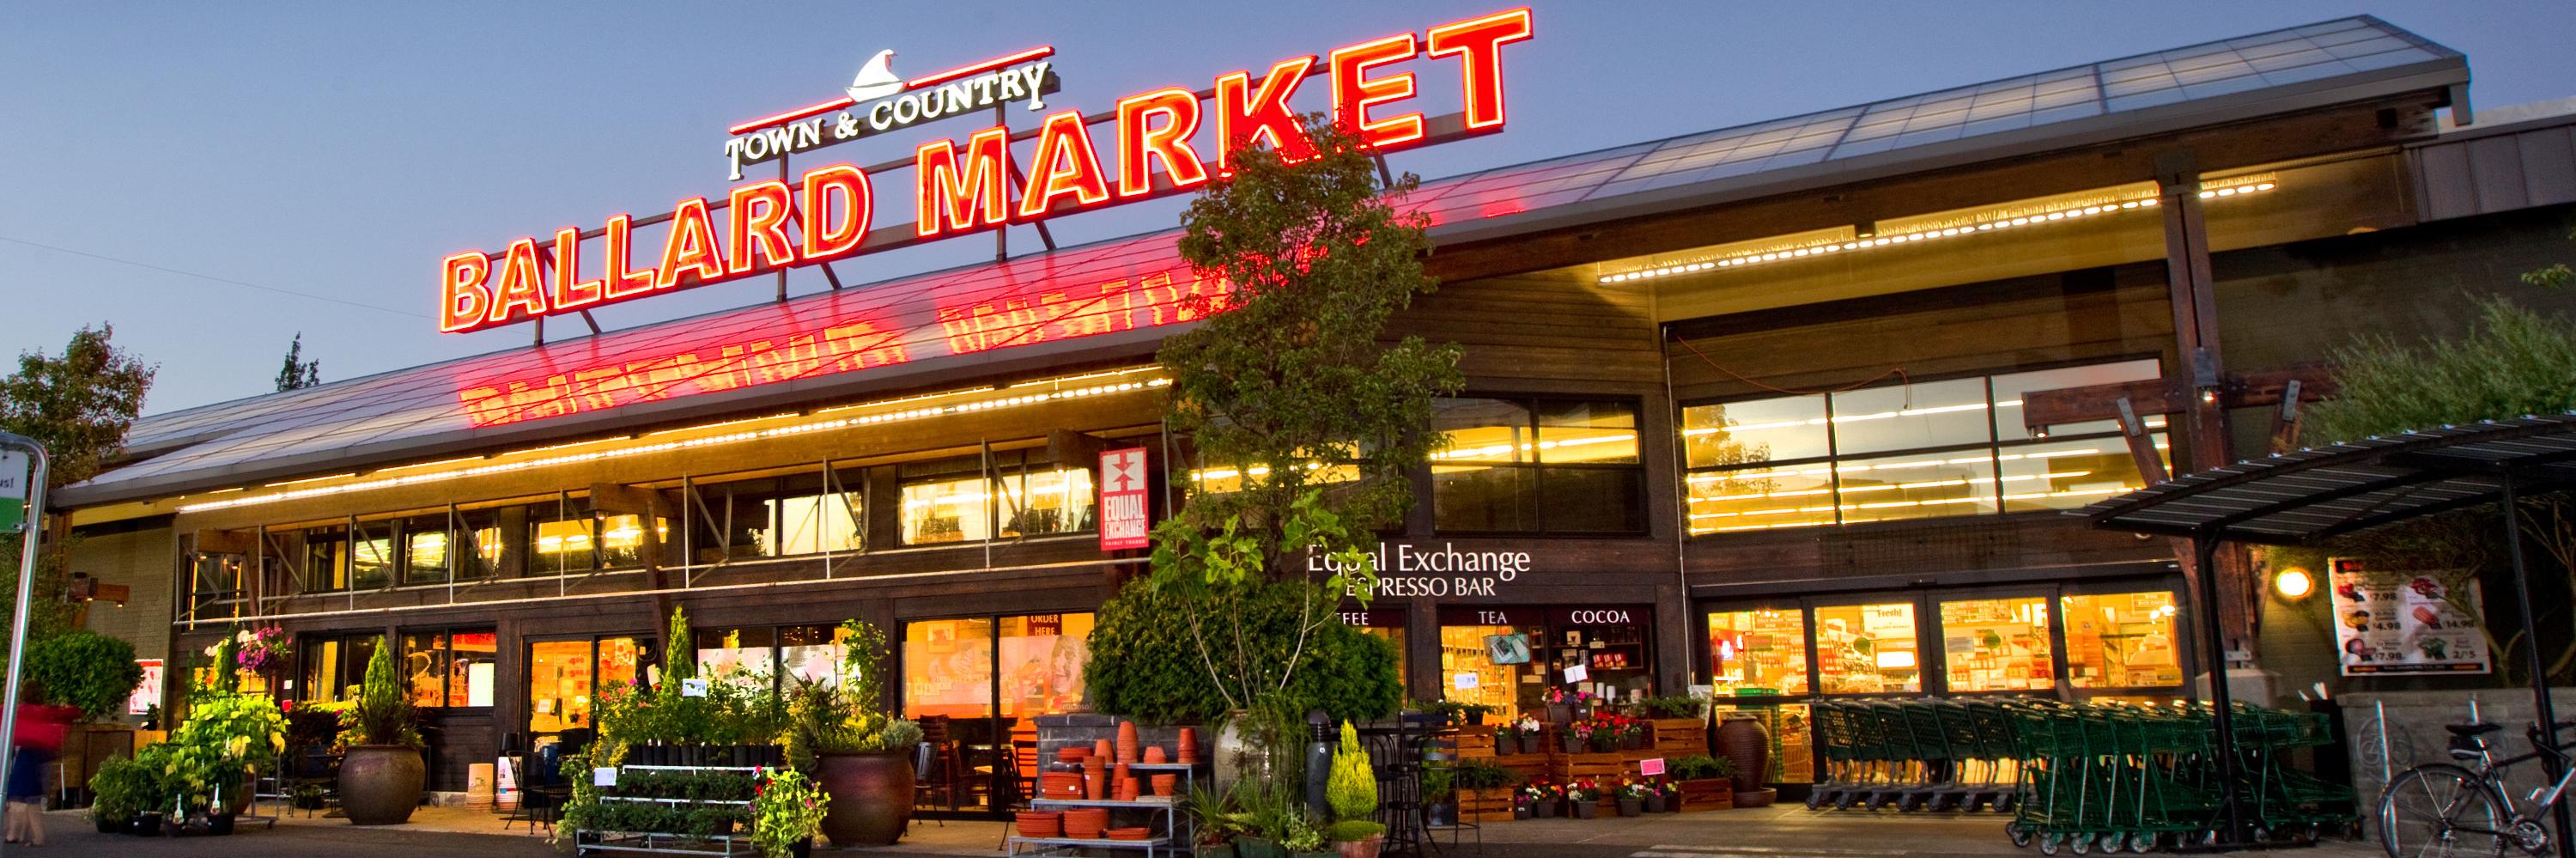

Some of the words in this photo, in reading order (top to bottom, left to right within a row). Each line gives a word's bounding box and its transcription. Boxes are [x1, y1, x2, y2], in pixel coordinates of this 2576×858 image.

[726, 118, 827, 180] TOWN
[834, 112, 859, 139] &
[869, 61, 1053, 131] COUNTRY
[440, 163, 873, 333] BALLARD
[916, 7, 1534, 237] MARKET
[1104, 495, 1145, 521] EQUAL
[1105, 520, 1145, 539] EXCHANGE
[1399, 543, 1531, 581] Exchange
[1455, 577, 1497, 596] BAR
[1030, 614, 1060, 624] ORDER
[1478, 611, 1508, 624] TEA
[1571, 611, 1631, 624] COCOA
[1035, 627, 1056, 636] HERE
